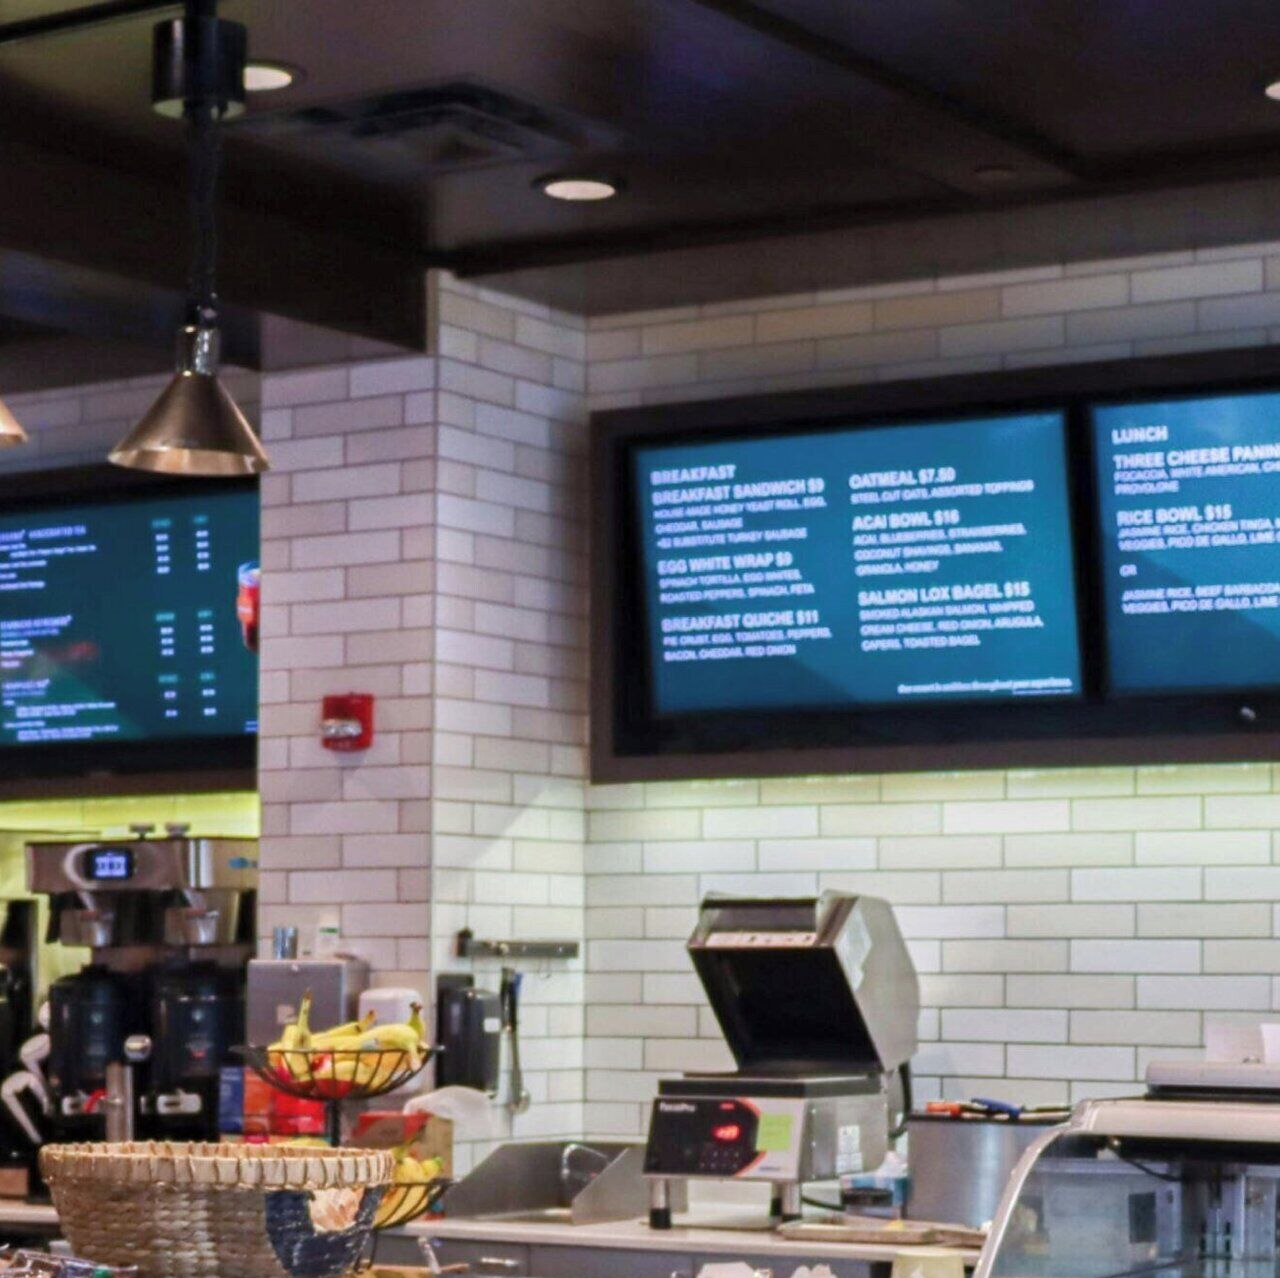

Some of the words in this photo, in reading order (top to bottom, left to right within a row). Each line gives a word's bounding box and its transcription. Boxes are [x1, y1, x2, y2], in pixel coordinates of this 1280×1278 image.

[1112, 425, 1168, 445] LUNCH
[1113, 452, 1165, 470] THREE
[1167, 447, 1230, 466] CHEESE
[650, 464, 736, 485] BREAKFAST
[849, 470, 917, 489] OATMEAL
[918, 467, 956, 484] $7.50
[652, 485, 730, 505] BREAKFAST
[733, 480, 806, 499] SANDWICH
[853, 515, 887, 530] ACAI
[889, 512, 932, 528] BOWL
[1117, 509, 1153, 526] RICE
[1155, 506, 1203, 523] BOWL
[1204, 504, 1232, 520] $15
[657, 560, 687, 574] EGG
[689, 557, 731, 571] WHITE
[733, 553, 773, 568] WRAP
[776, 552, 793, 567] $9
[858, 588, 918, 606] SALMON
[920, 585, 950, 602] LOX
[952, 583, 1003, 600] BAGEL
[1004, 581, 1030, 597] $15
[661, 614, 740, 632] BREAKFAST
[743, 611, 794, 627] QUICHE
[796, 610, 818, 625] $11
